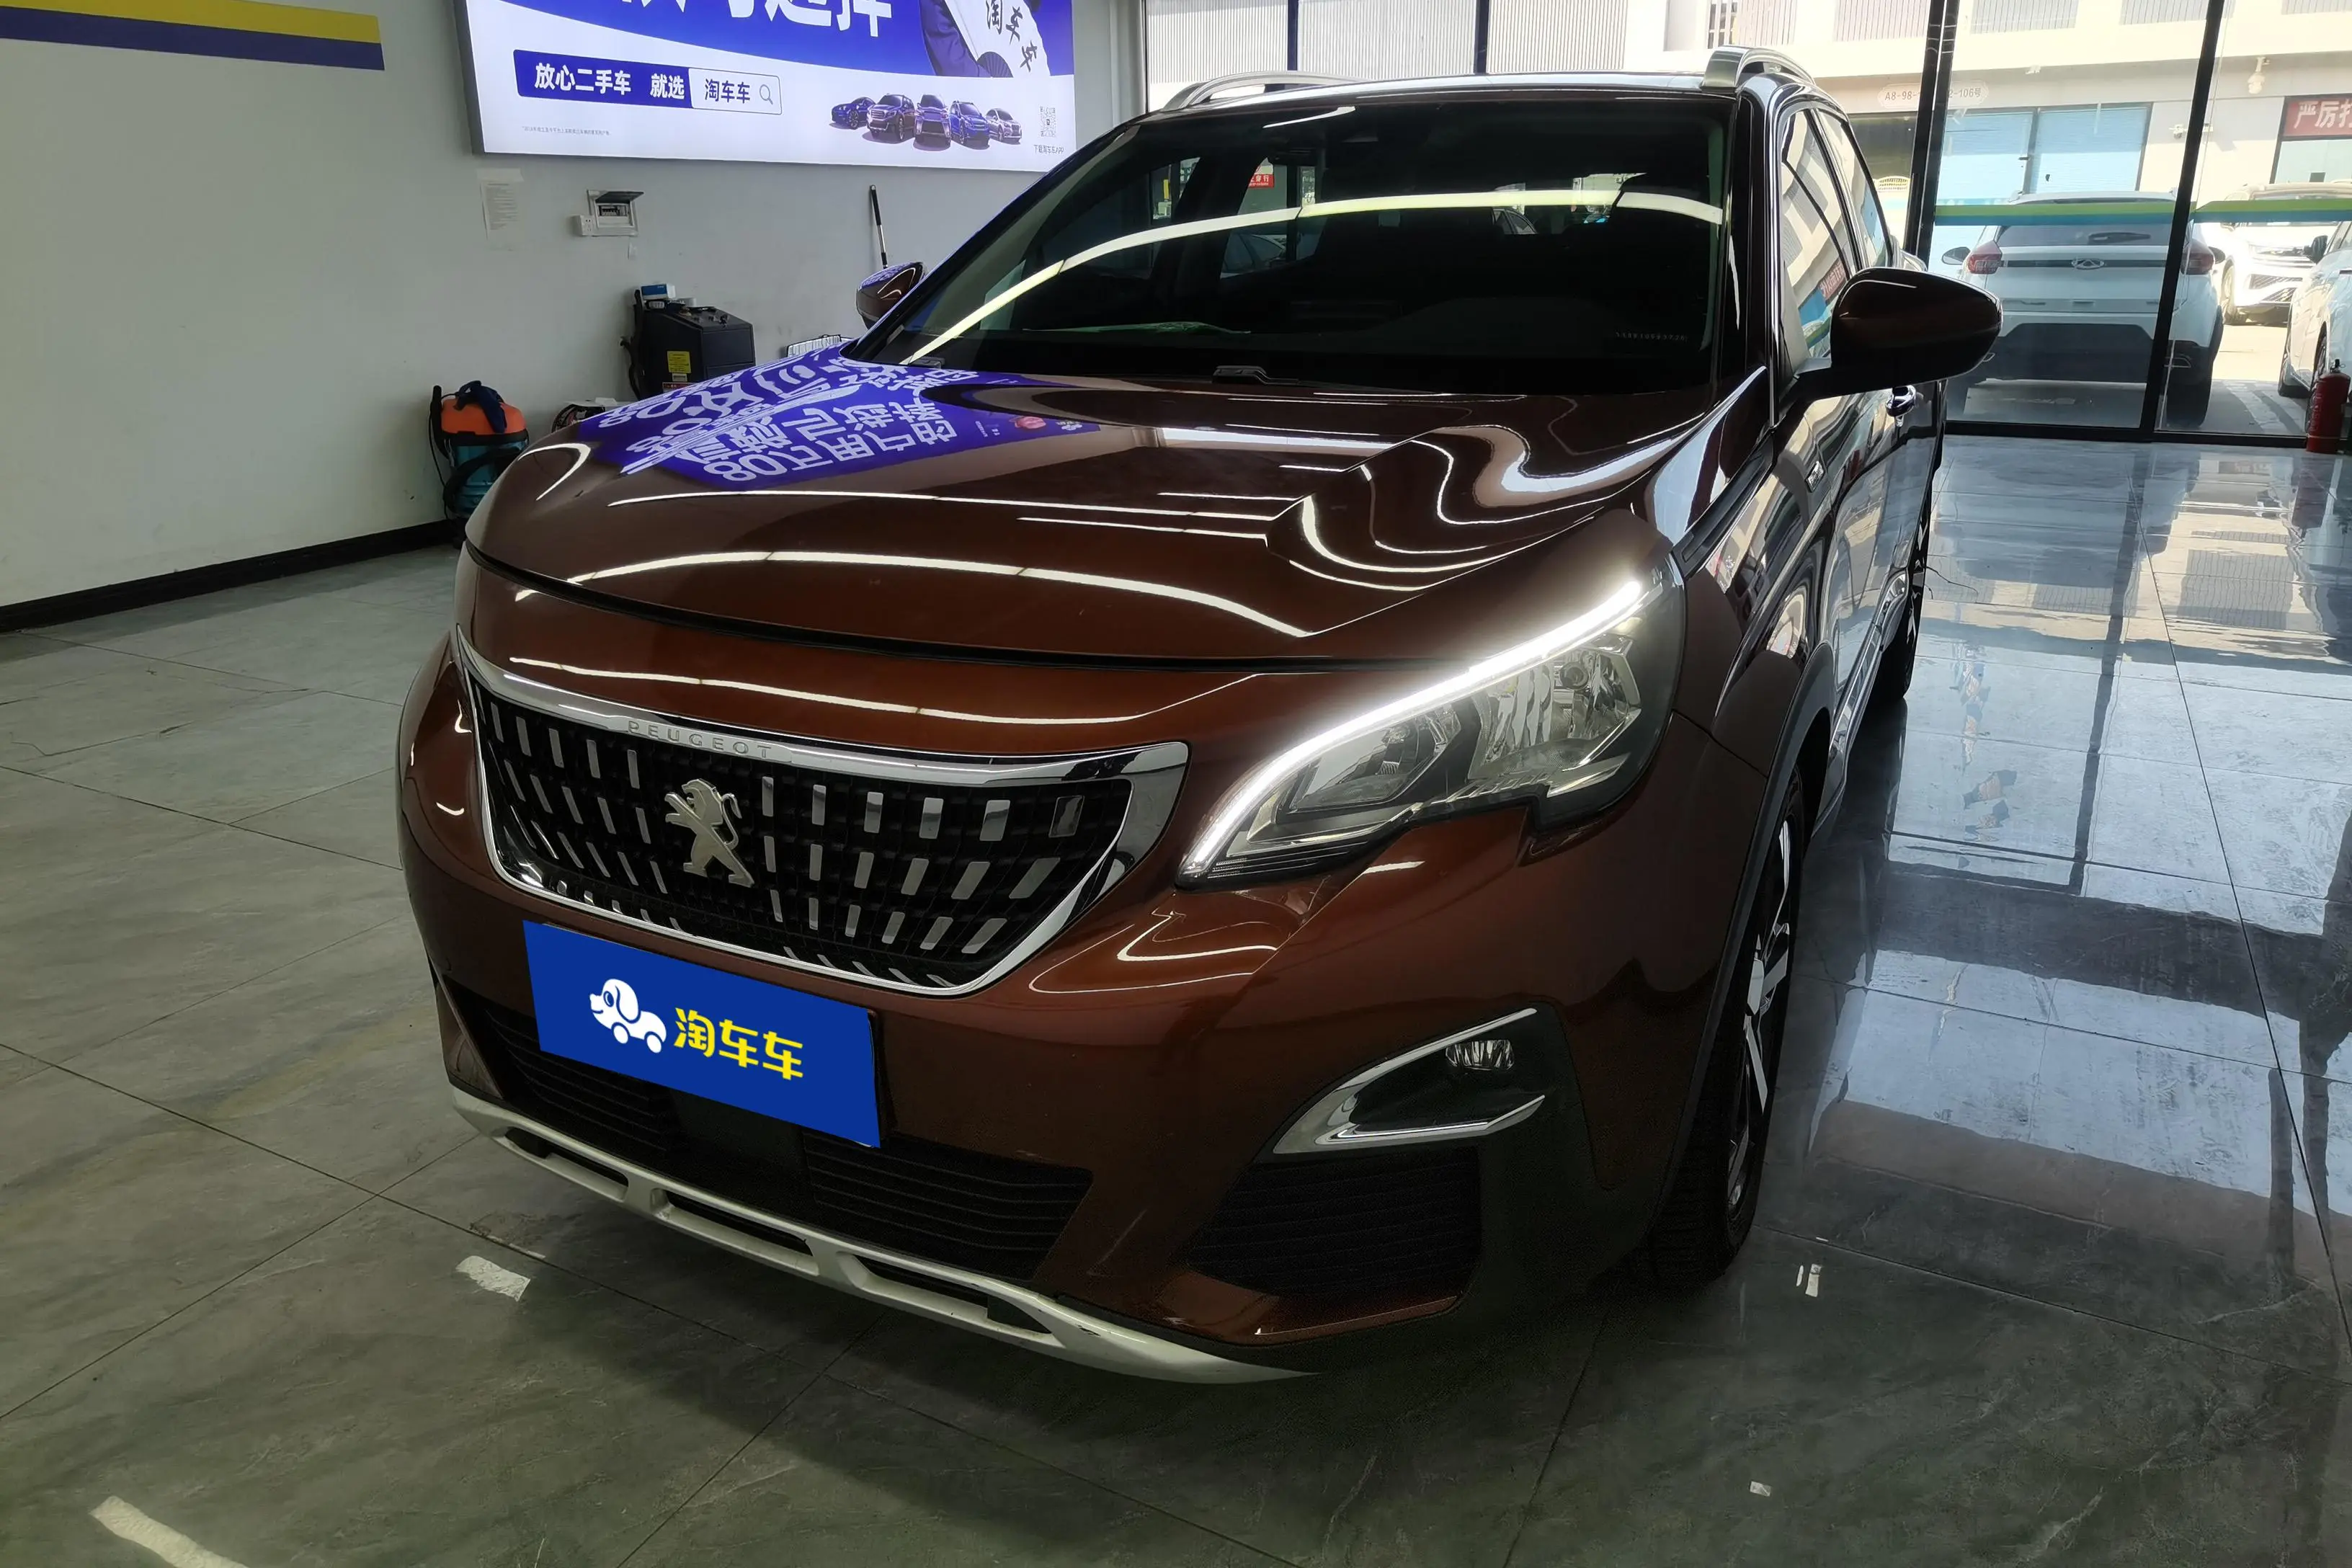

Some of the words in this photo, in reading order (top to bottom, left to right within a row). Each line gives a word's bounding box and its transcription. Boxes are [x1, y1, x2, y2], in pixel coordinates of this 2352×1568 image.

[534, 62, 632, 96] 放心二手车
[650, 73, 685, 100] 就选
[704, 78, 751, 104] 淘车车
[628, 720, 771, 760] PEUGEOT
